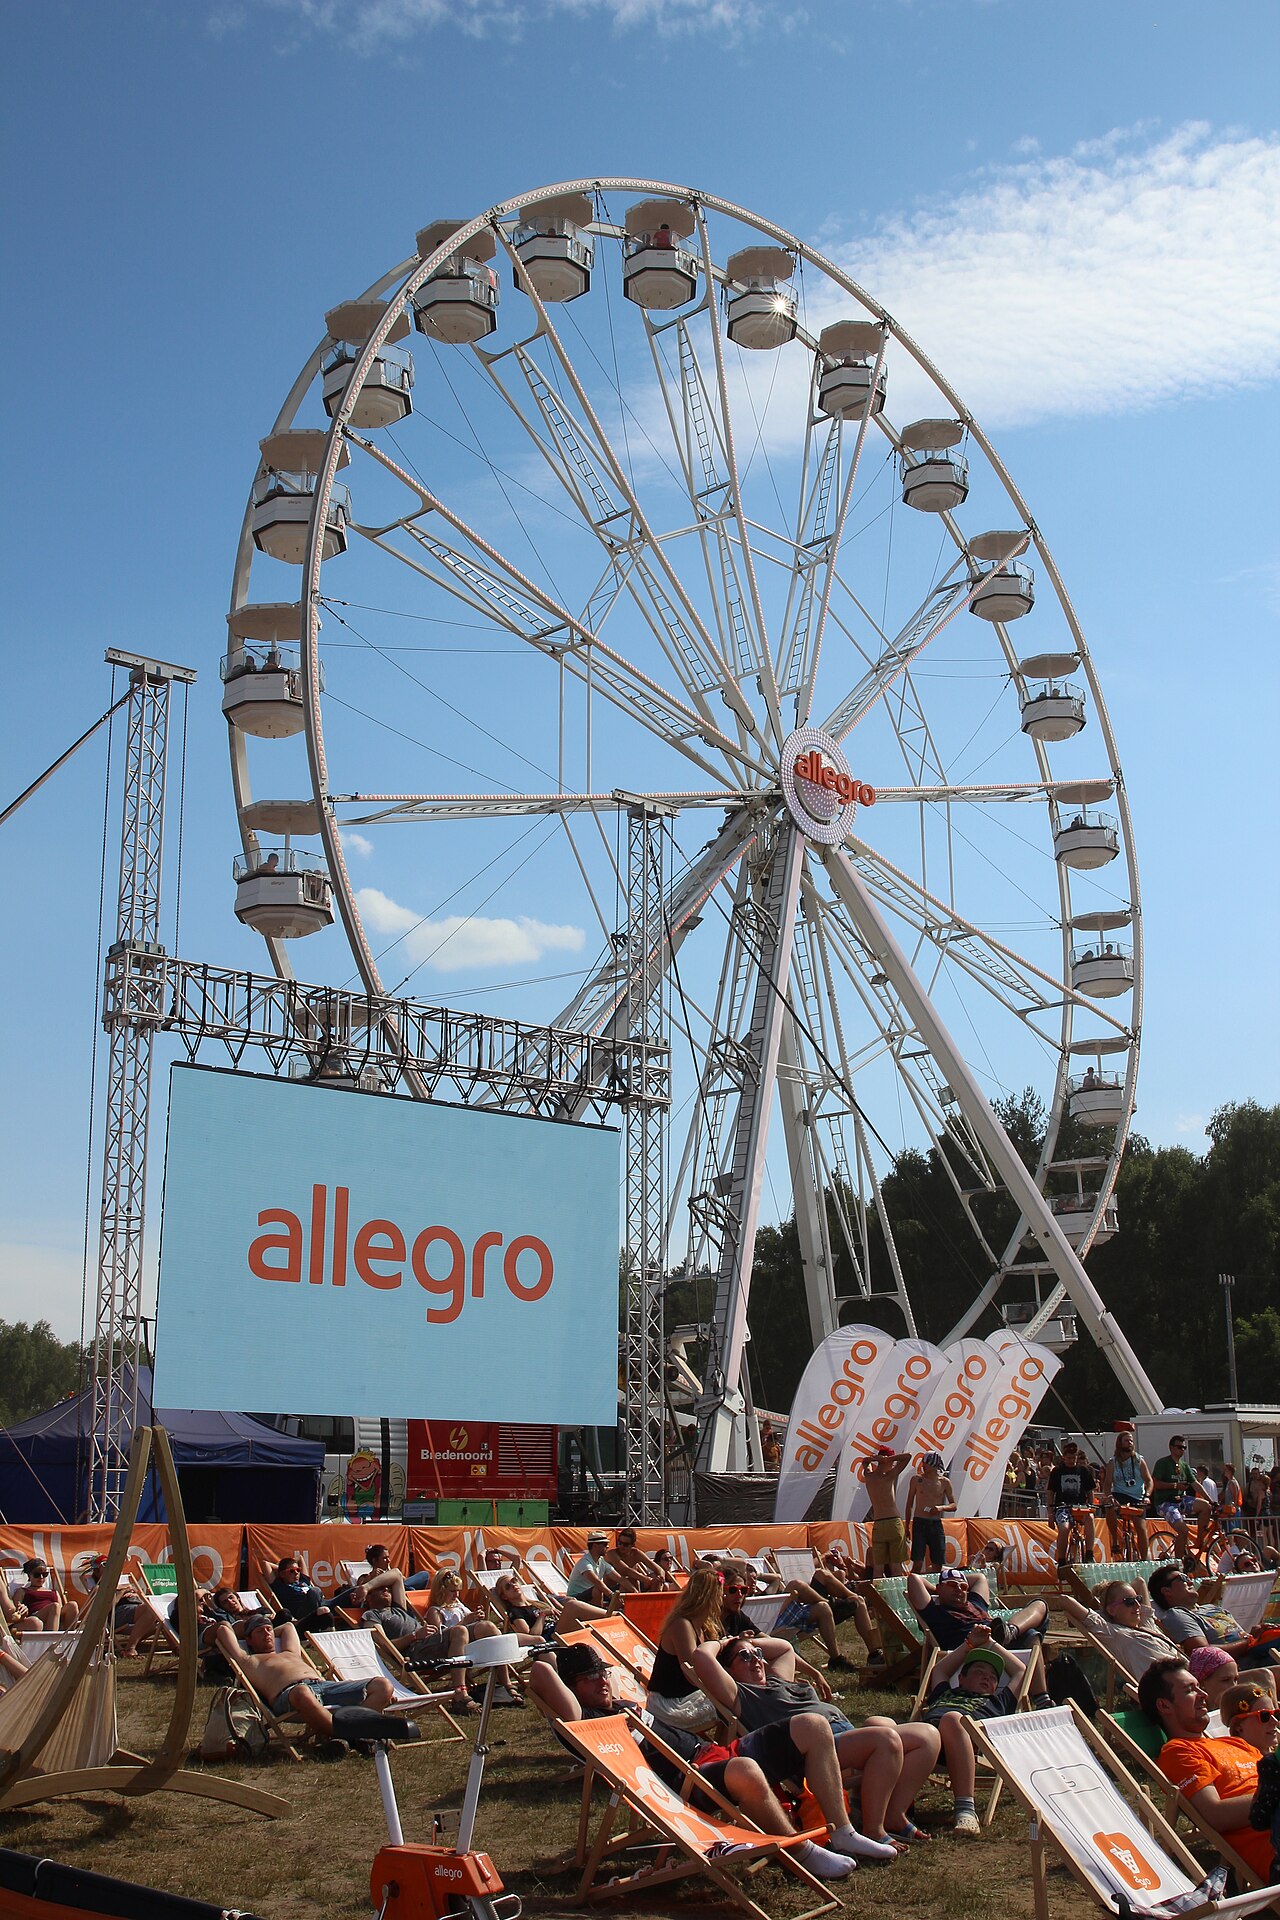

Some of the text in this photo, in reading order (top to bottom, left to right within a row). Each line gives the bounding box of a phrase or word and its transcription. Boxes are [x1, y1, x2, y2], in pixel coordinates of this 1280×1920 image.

[793, 750, 876, 807] allegro
[247, 1183, 554, 1324] allegro
[794, 1339, 878, 1472] allegro
[963, 1357, 1045, 1482] allegro
[420, 1449, 493, 1460] Bredenoord
[434, 1864, 463, 1881] allegro
